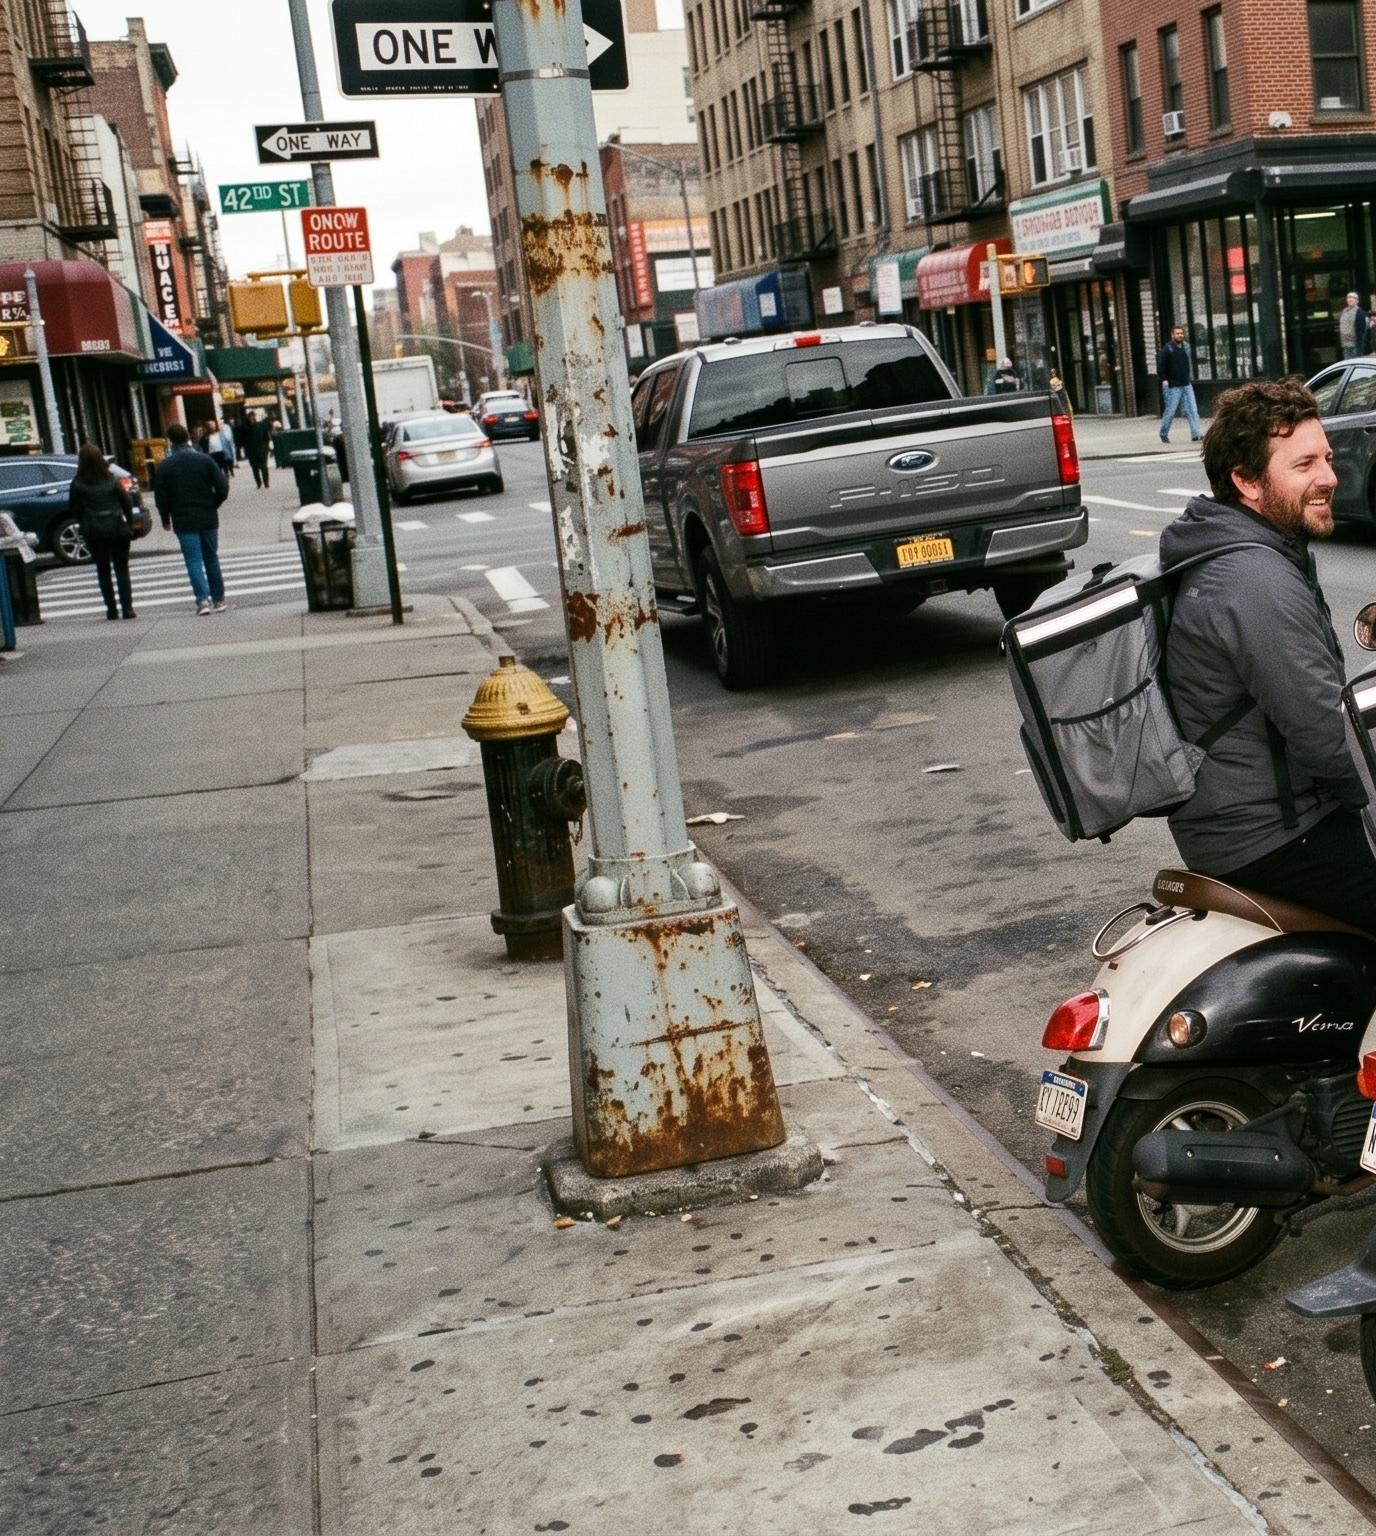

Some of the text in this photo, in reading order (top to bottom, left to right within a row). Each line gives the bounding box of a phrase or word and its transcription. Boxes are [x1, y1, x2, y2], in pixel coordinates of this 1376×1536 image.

[373, 28, 457, 65] ONE
[276, 133, 361, 152] ONE WAY
[278, 183, 301, 207] ST
[308, 231, 366, 251] ROUTE
